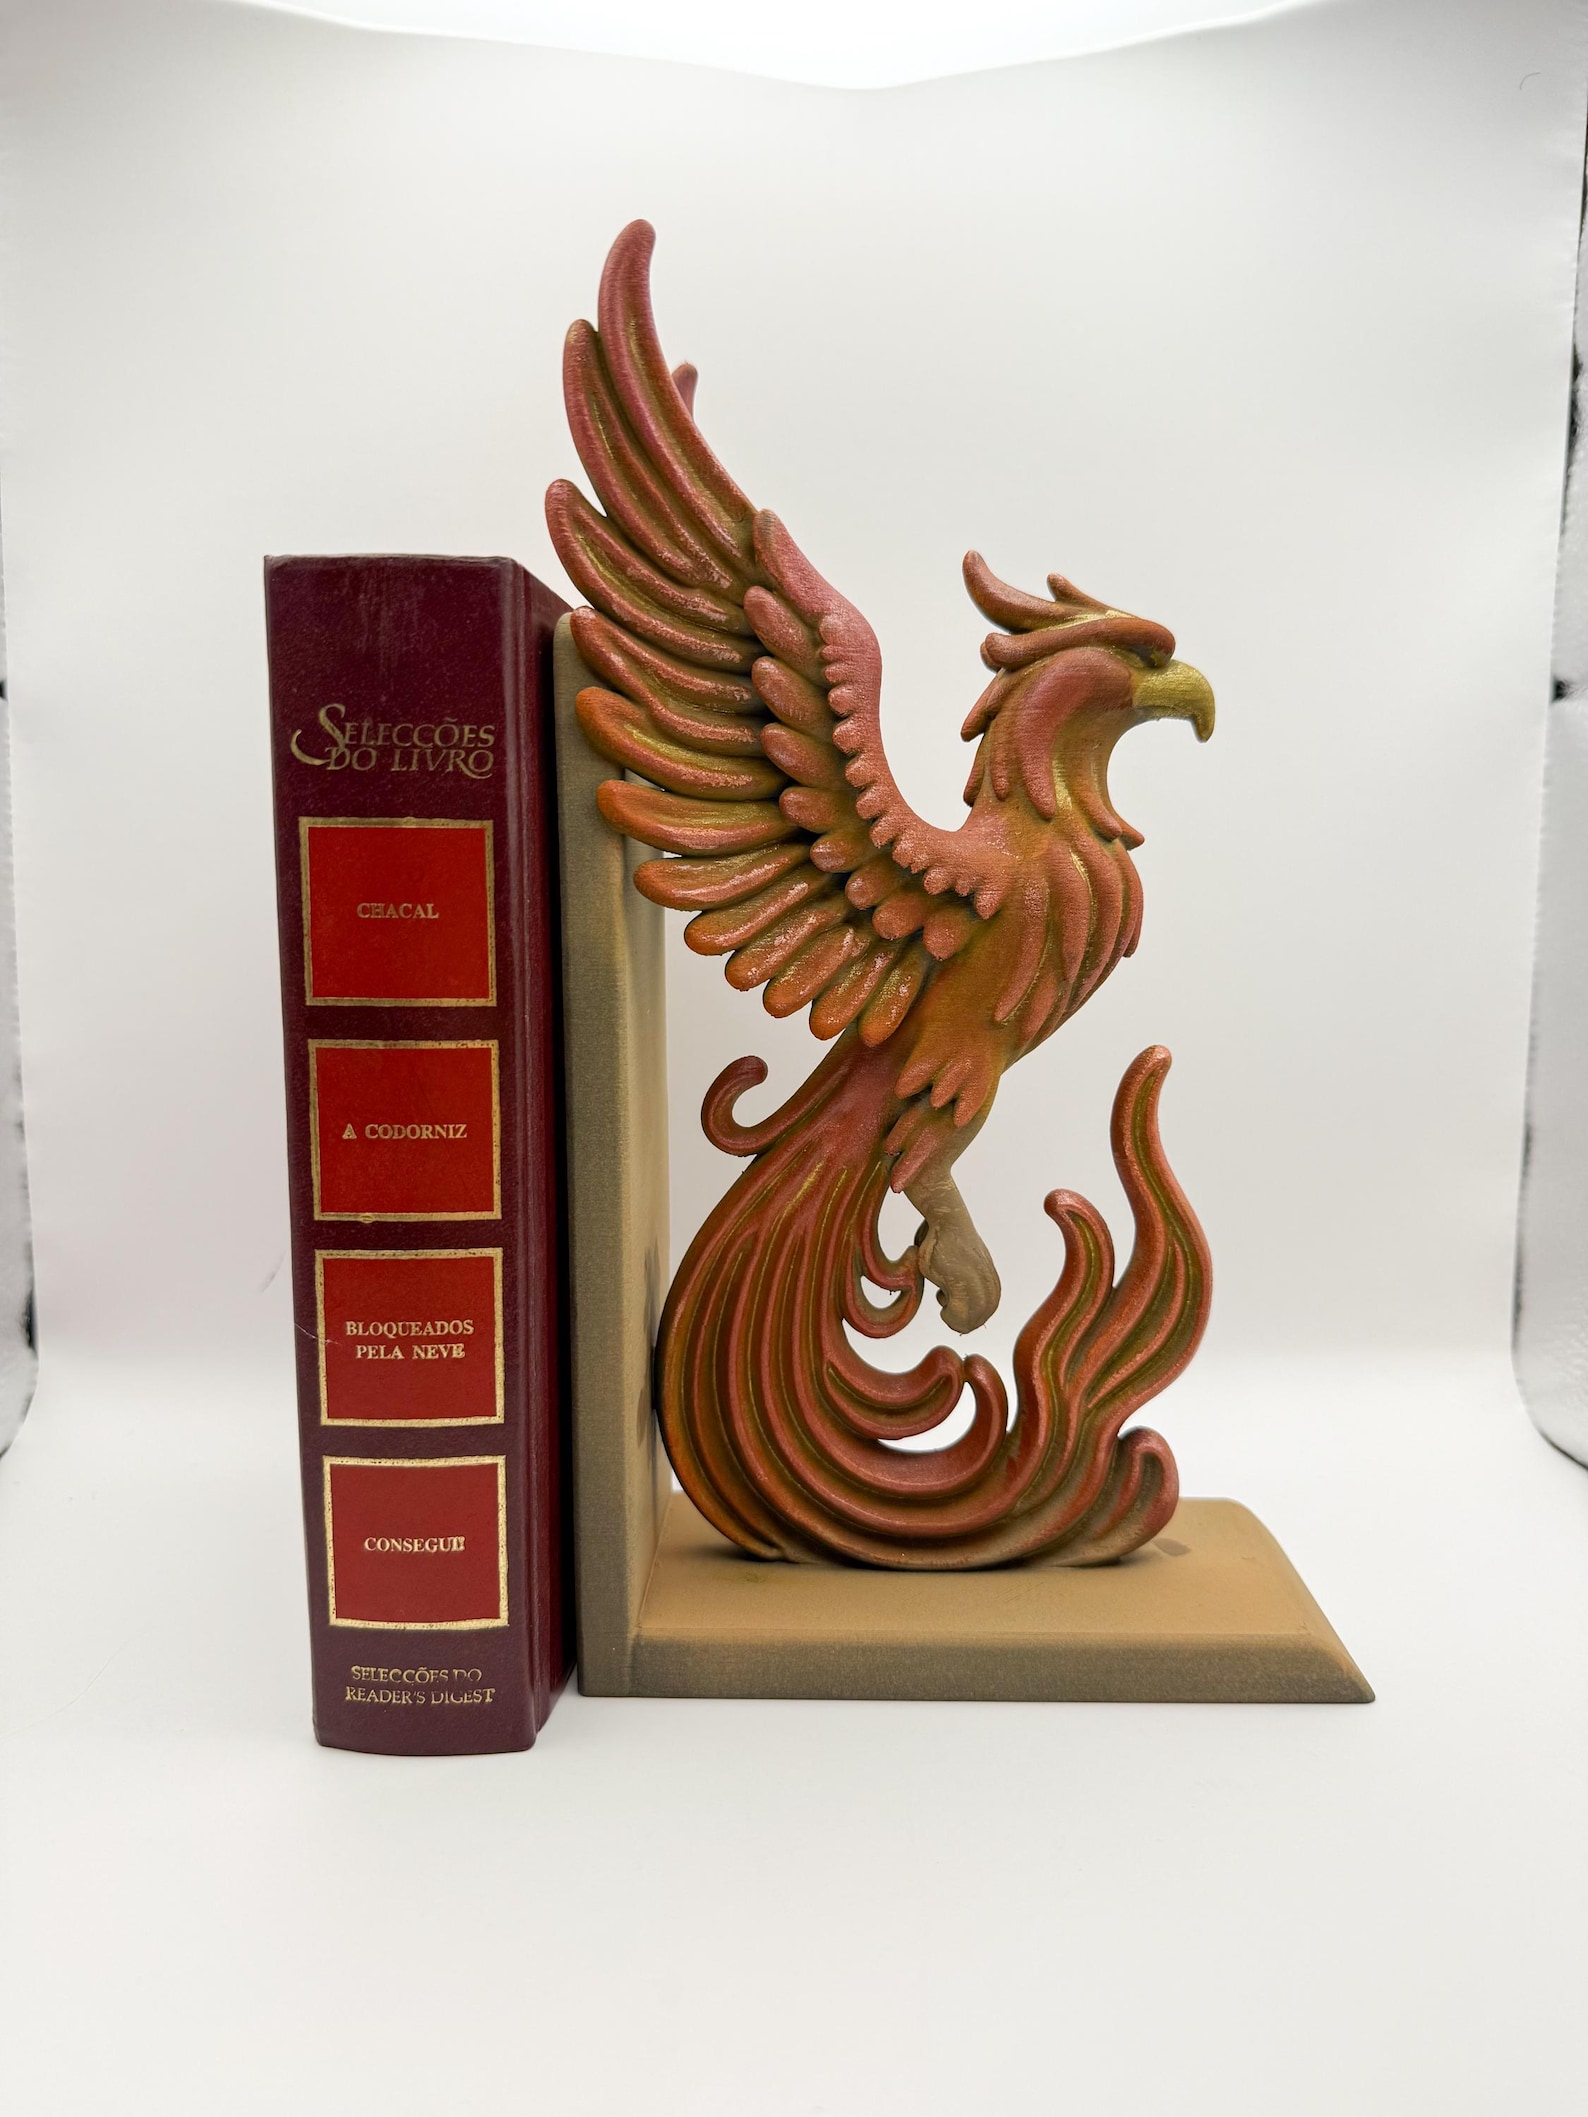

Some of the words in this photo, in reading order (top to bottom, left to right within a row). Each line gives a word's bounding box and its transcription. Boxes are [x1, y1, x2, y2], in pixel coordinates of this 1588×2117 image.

[325, 746, 378, 772] DO
[390, 748, 494, 780] LIVRO
[356, 902, 440, 919] CHACAL
[342, 1123, 358, 1140] A
[364, 1123, 468, 1140] CODORNIZ
[345, 1319, 475, 1339] BLOQUEADOS
[356, 1344, 405, 1360] PELA
[412, 1343, 466, 1360] NEVE
[345, 1686, 426, 1705] READER'S
[431, 1688, 496, 1705] DIGEST
